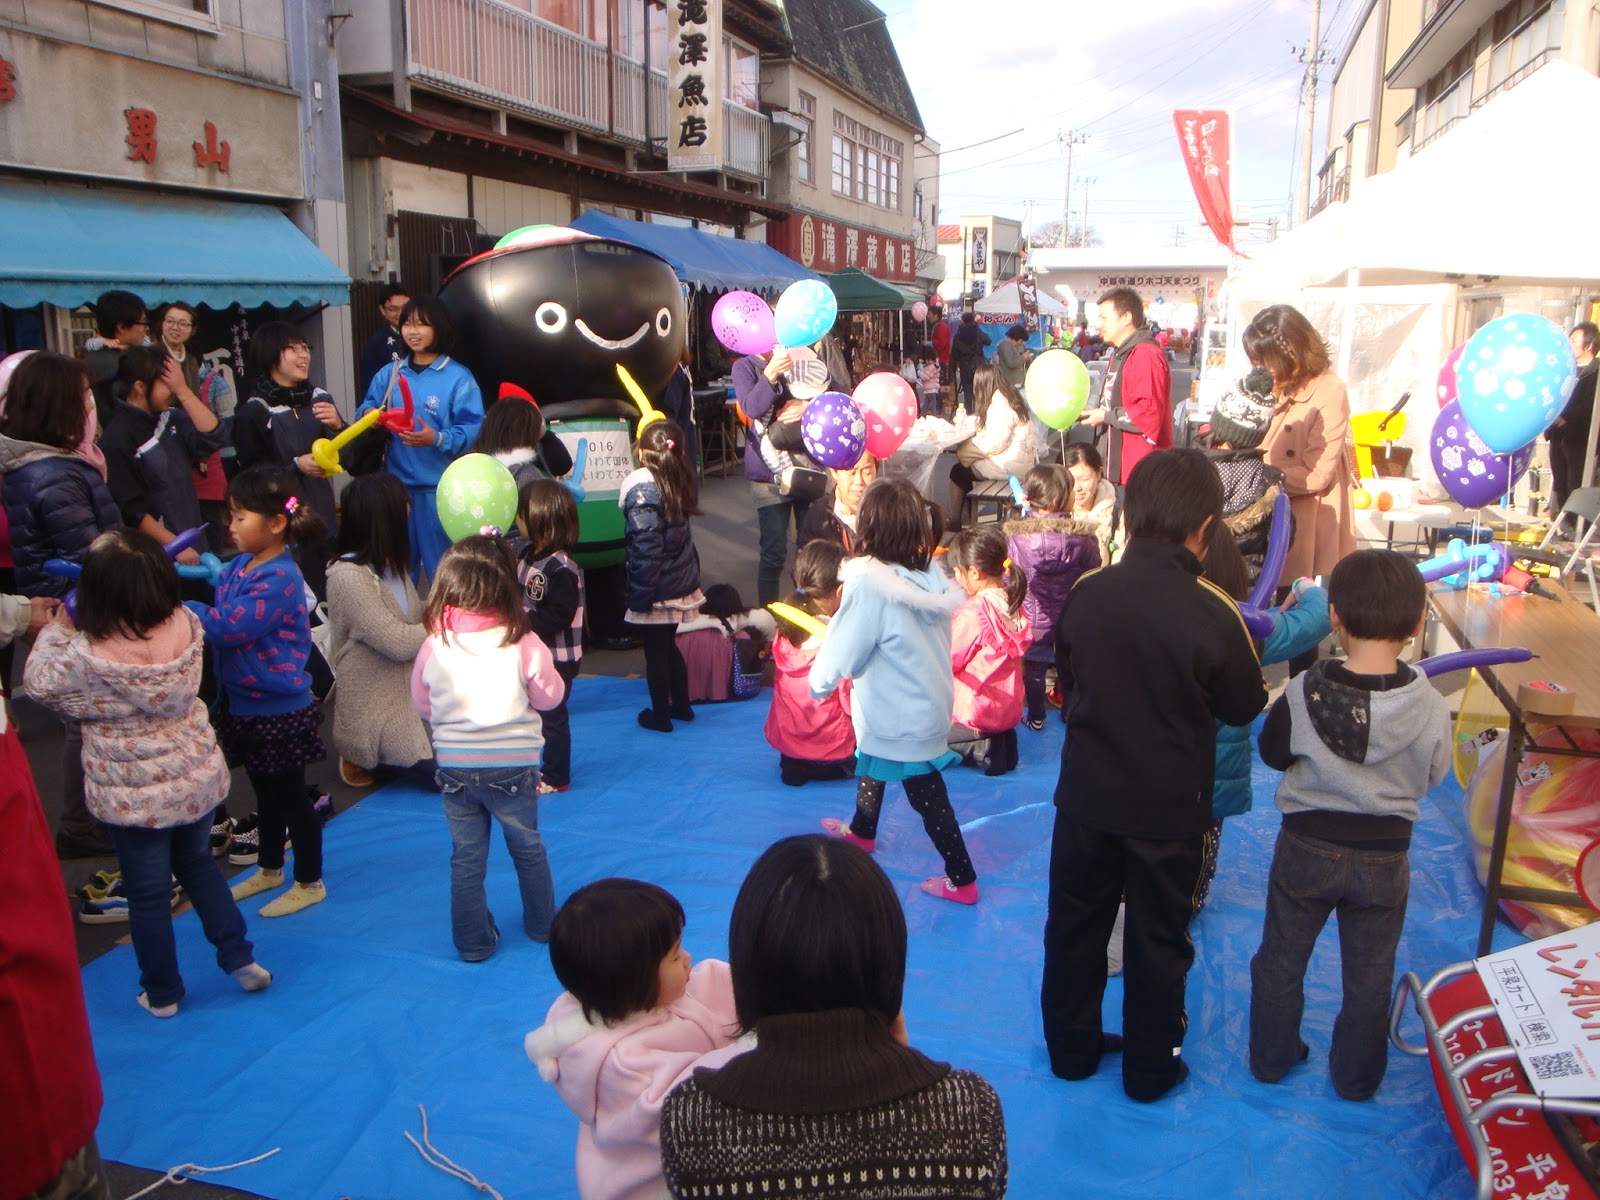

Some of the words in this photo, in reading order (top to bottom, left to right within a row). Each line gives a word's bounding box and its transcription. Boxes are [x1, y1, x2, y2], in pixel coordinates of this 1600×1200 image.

[123, 106, 231, 173] 男山
[1100, 276, 1200, 286] 中尊寺通りホコ天まつり
[983, 315, 1016, 323] おでん
[589, 441, 613, 452] 016
[525, 572, 546, 601] G
[1497, 966, 1535, 1011] 平泉カート
[1526, 1022, 1551, 1042] 検索
[1537, 943, 1600, 1041] レンタル
